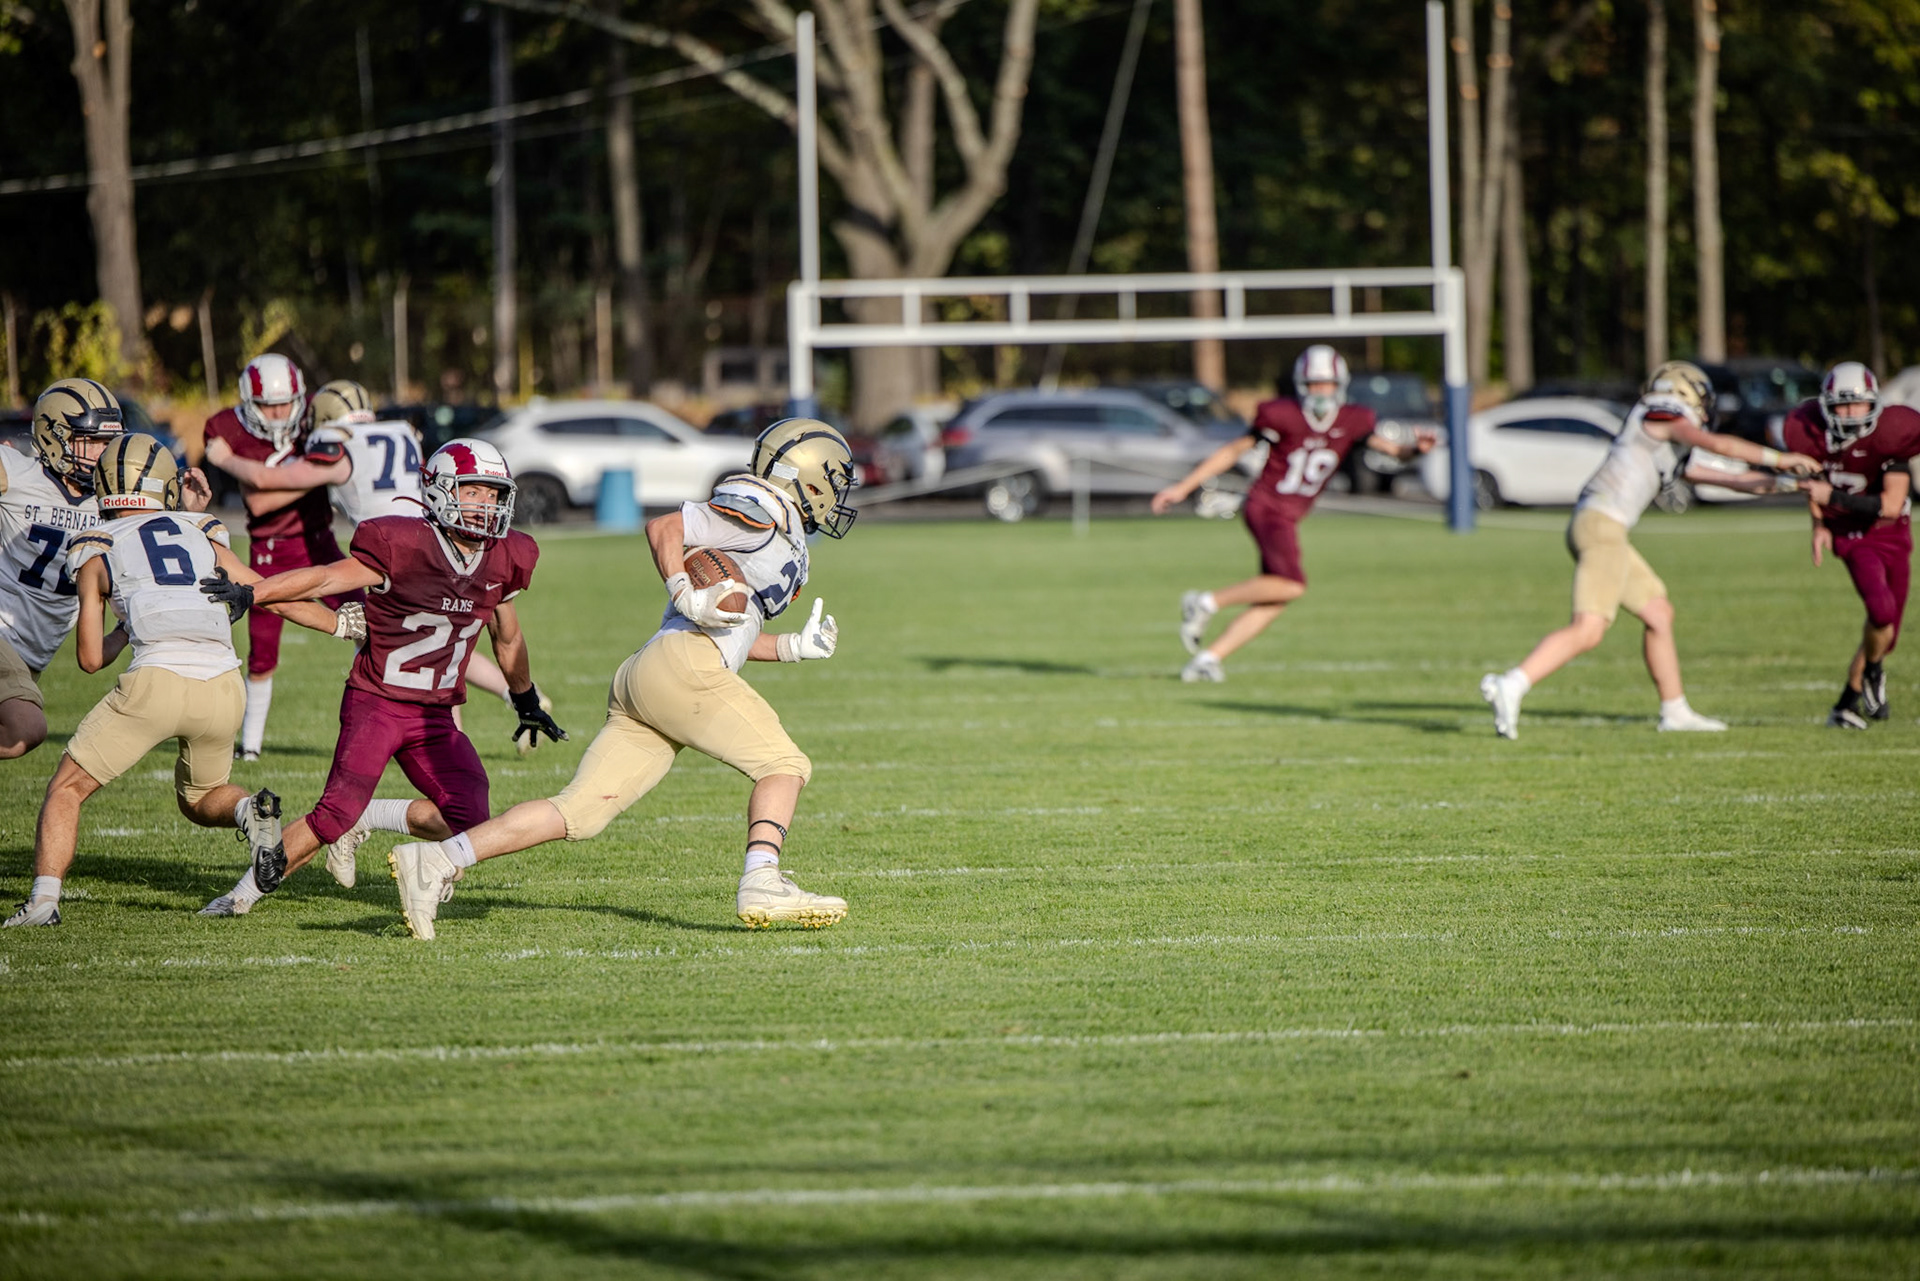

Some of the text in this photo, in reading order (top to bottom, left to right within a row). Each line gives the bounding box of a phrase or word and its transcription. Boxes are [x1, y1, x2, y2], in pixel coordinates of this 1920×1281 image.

[366, 434, 422, 491] 74
[1275, 447, 1340, 497] 19
[24, 504, 42, 523] ST.
[103, 498, 146, 507] Riddell
[138, 516, 196, 585] 6
[691, 558, 711, 584] Wilson
[383, 611, 483, 691] 21
